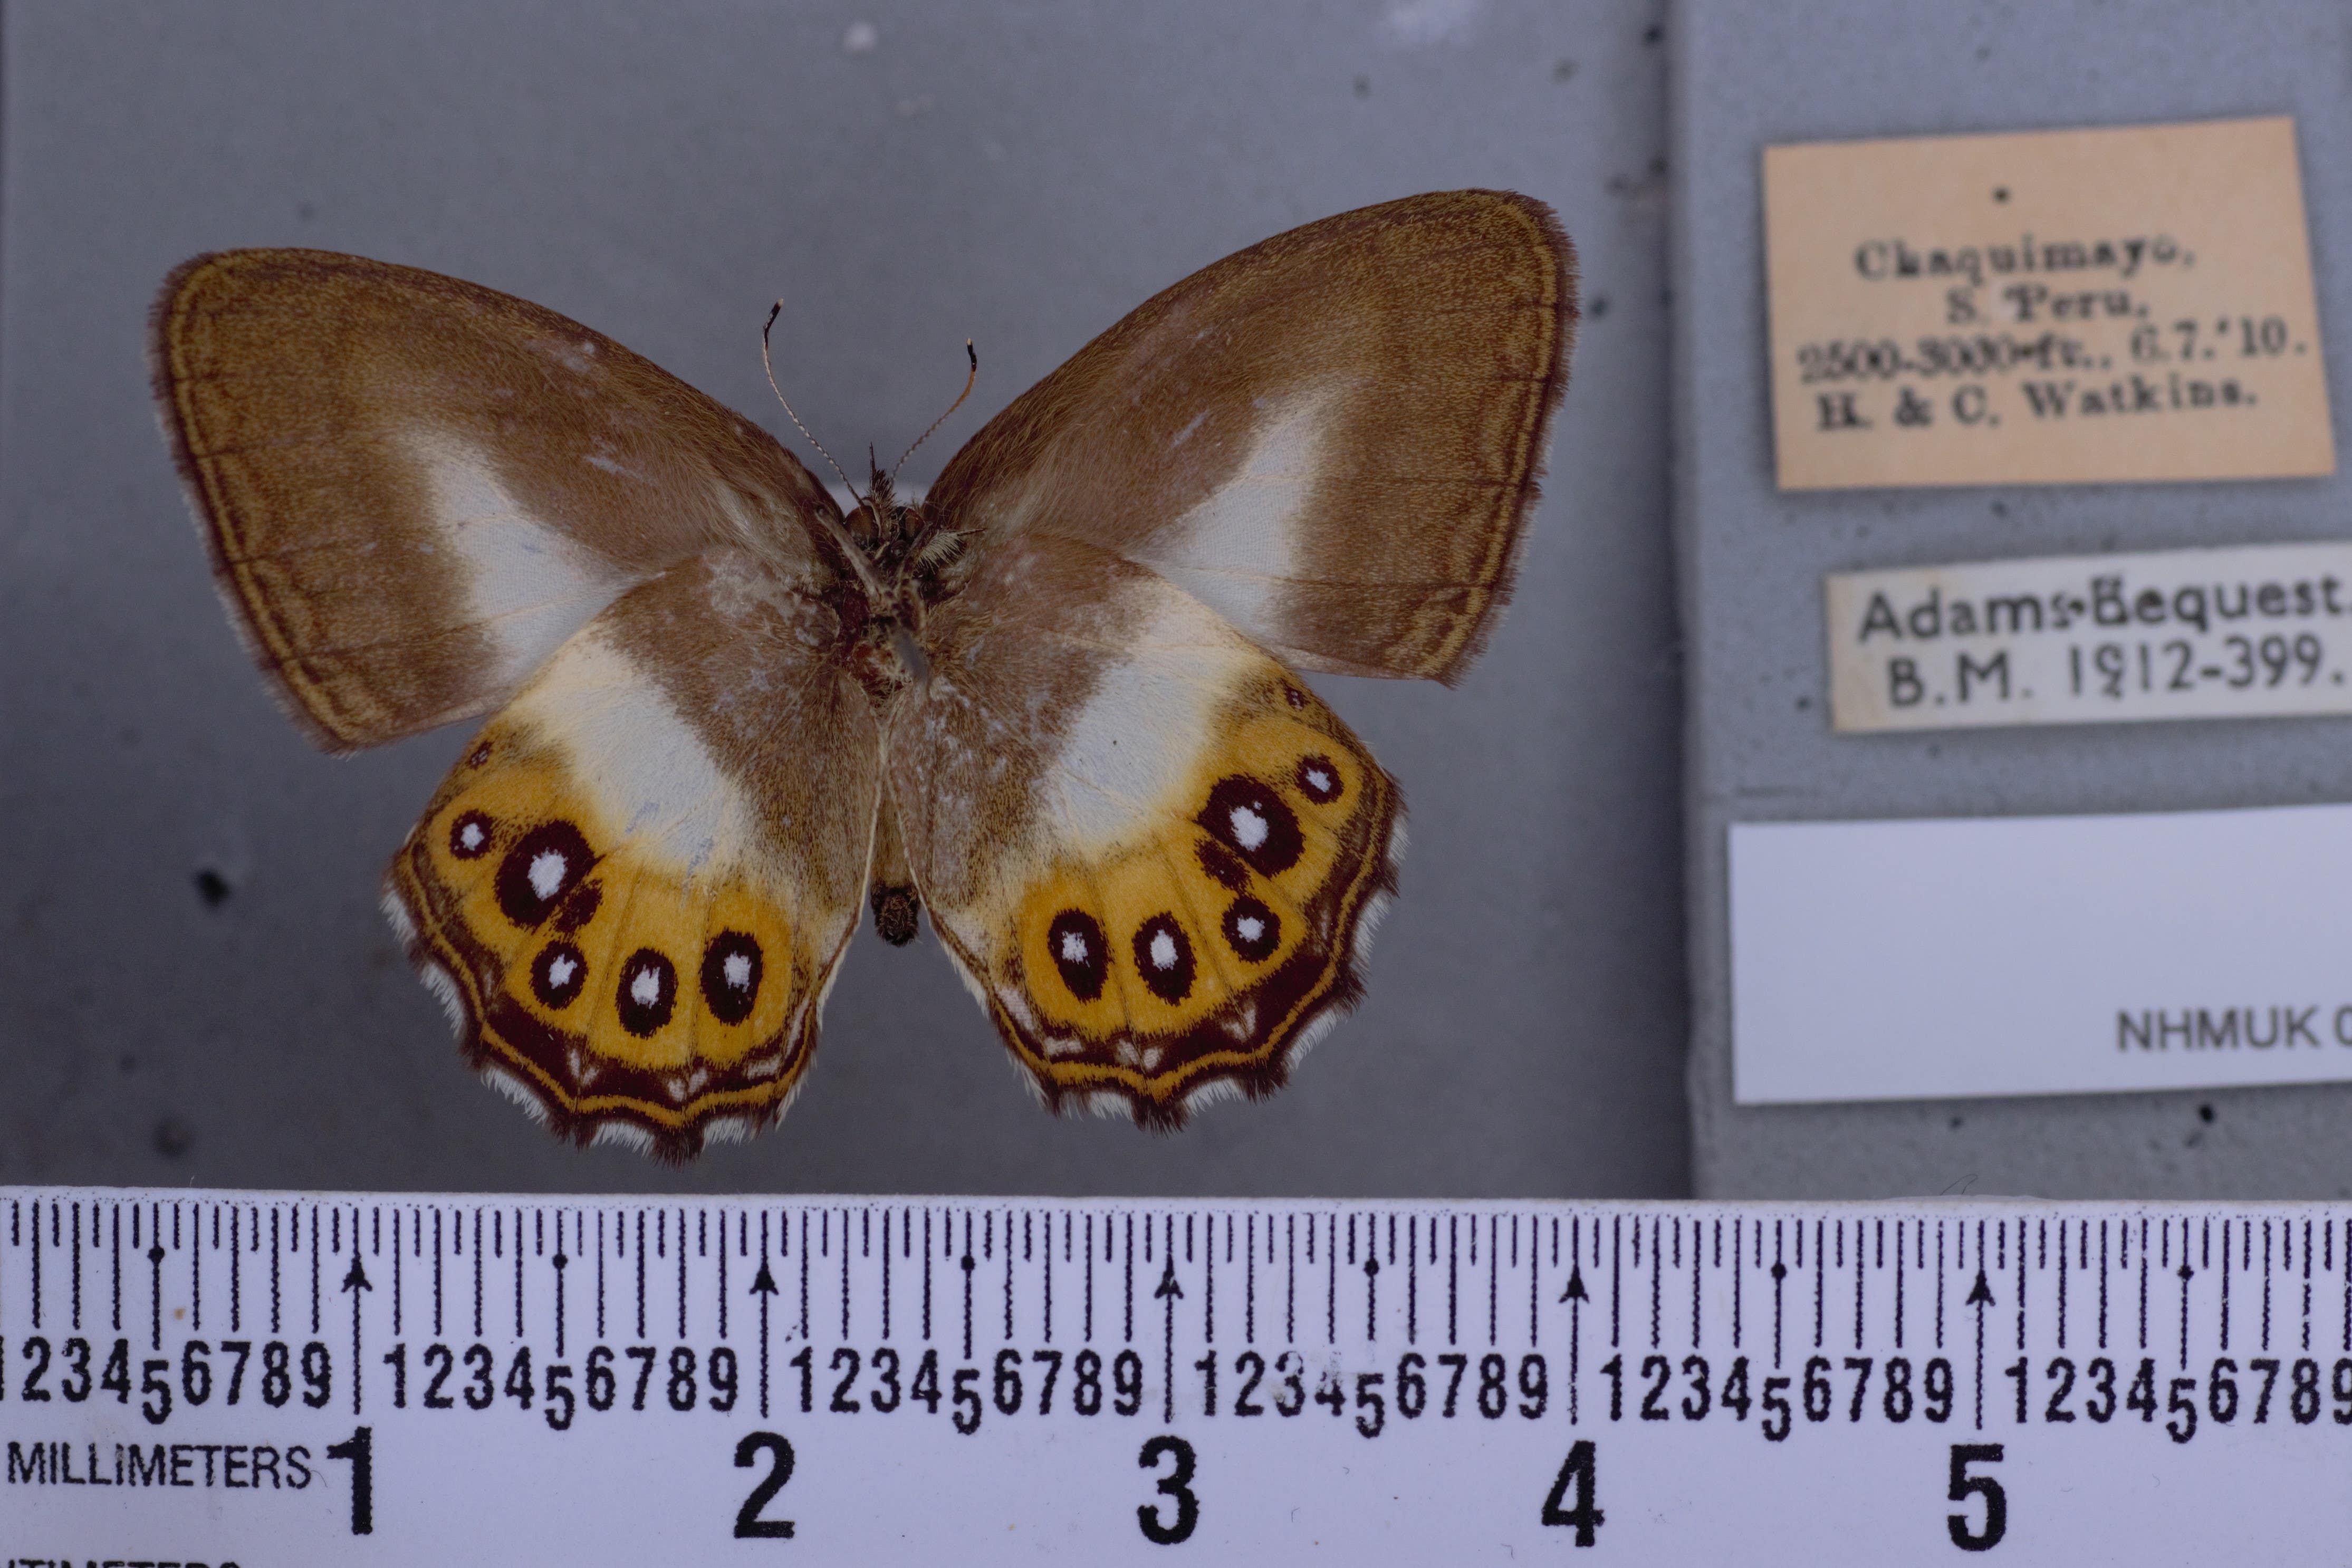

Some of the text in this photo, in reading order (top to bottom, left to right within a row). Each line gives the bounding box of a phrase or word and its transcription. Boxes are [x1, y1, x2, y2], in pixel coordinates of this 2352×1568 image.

[1895, 386, 1932, 428] &
[1953, 384, 2001, 425] C.
[1888, 648, 2033, 708] B.M.
[2117, 1005, 2321, 1050] NHMUK
[21, 1336, 51, 1402] 2
[62, 1338, 92, 1402] 3
[100, 1339, 131, 1404] 4
[141, 1360, 172, 1425] 5
[181, 1340, 212, 1406] 6
[221, 1341, 251, 1405] 7
[262, 1341, 291, 1408] 8
[301, 1342, 332, 1409] 9
[383, 1343, 737, 1431] 1 2 3 4 5 6 7 8 9
[790, 1346, 1143, 1435] 1 2 3 4 5 6 7 8 9
[1195, 1350, 1216, 1416] 1
[1235, 1351, 1265, 1417] 2
[1275, 1351, 1305, 1417] 3
[1356, 1373, 1385, 1439] 5
[1397, 1353, 1426, 1419] 6
[1438, 1354, 1467, 1418] 7
[1477, 1354, 1508, 1419] 8
[1519, 1354, 1548, 1419] 9
[1600, 1354, 1954, 1442] 1 2 3 4 5 6 7 8 9
[2005, 1357, 2028, 1423] 1
[2046, 1357, 2076, 1423] 2
[2086, 1358, 2116, 1423] 3
[2127, 1358, 2157, 1422] 4
[2166, 1378, 2197, 1444] 5
[2209, 1358, 2238, 1423] 6
[2250, 1359, 2280, 1423] 7
[2291, 1358, 2320, 1425] 8
[7, 1441, 311, 1489] MILLIMETERS
[327, 1426, 372, 1535] 1
[734, 1431, 795, 1539] 2
[1137, 1436, 1199, 1545] 3
[1541, 1440, 1605, 1547] 4
[1947, 1444, 2007, 1551] 5
